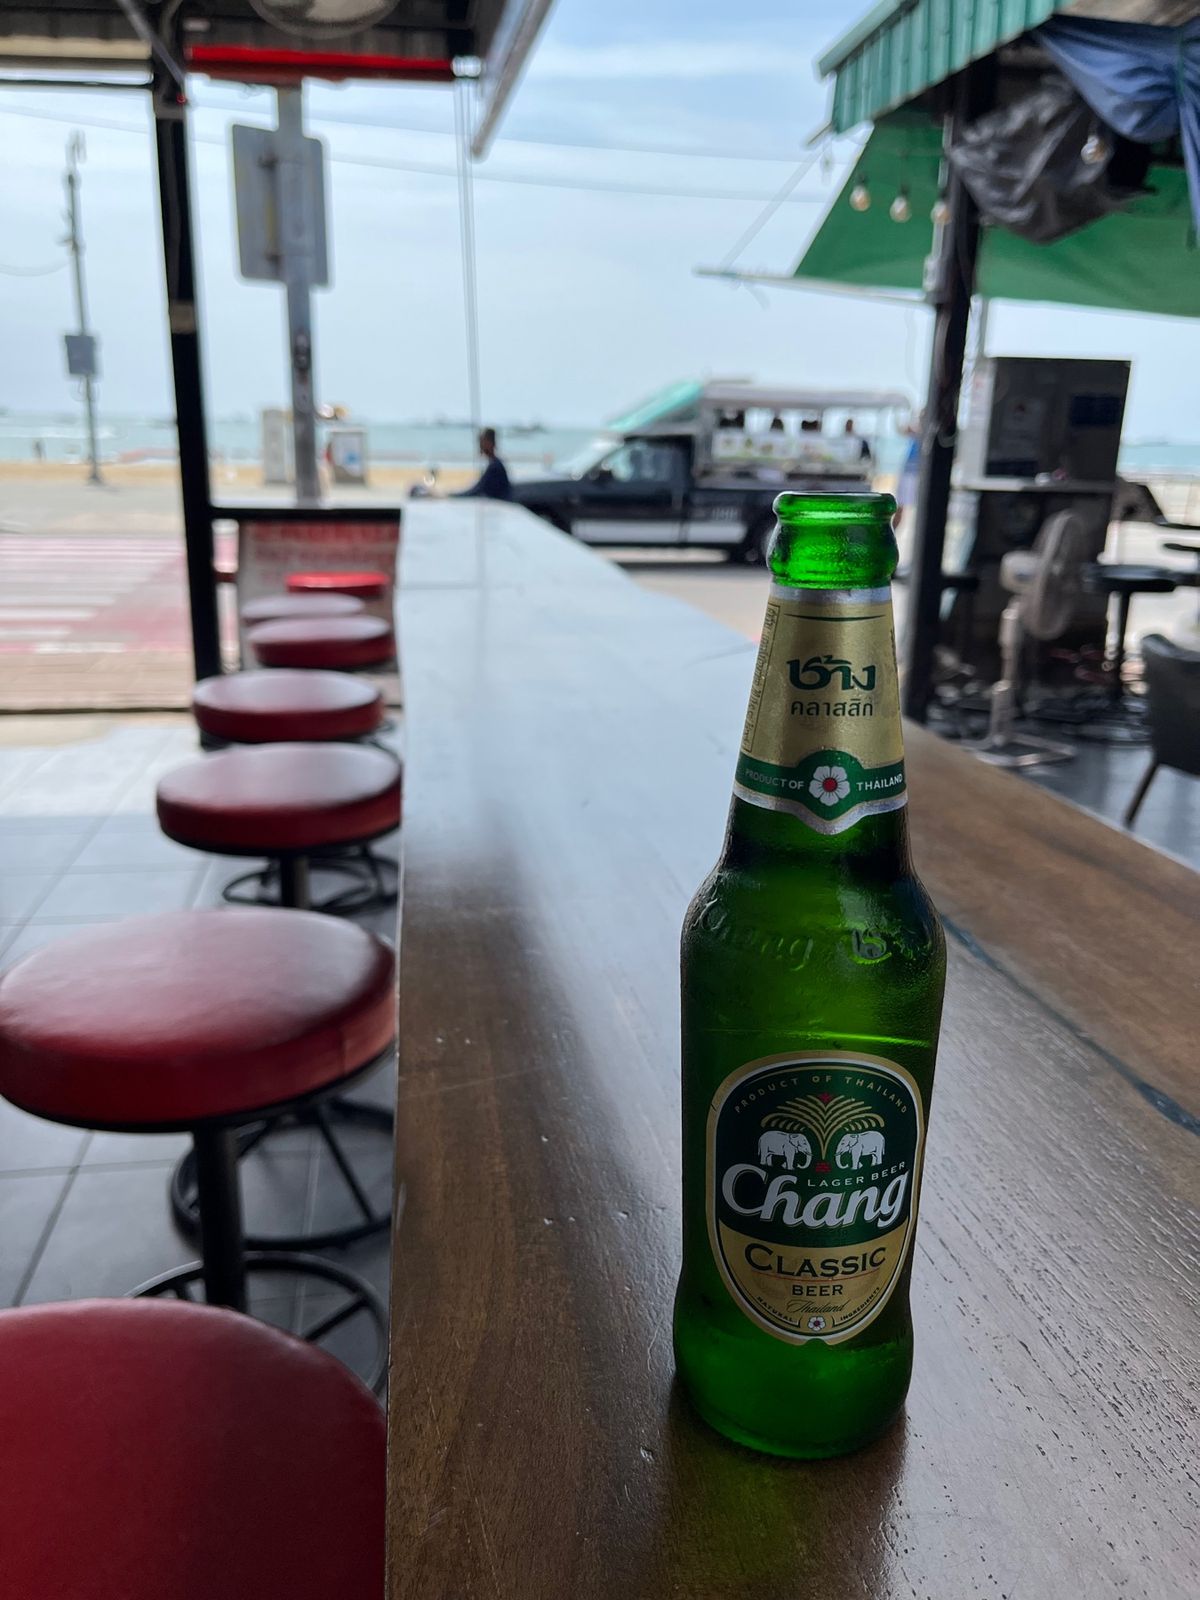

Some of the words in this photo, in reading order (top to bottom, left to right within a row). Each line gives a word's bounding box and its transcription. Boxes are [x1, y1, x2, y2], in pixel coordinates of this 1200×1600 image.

[786, 655, 876, 691] ช้าง
[744, 768, 786, 787] PRODUCT
[788, 779, 805, 790] OF
[856, 773, 903, 792] THAILAND
[734, 1078, 799, 1114] PRODUCT
[811, 1075, 833, 1084] OF
[844, 1075, 908, 1114] THAILAND
[807, 1176, 865, 1188] LAGER
[871, 1161, 906, 1182] BEER
[721, 1163, 911, 1228] Chang
[744, 1243, 887, 1278] CLASSIC
[792, 1284, 843, 1297] BEER
[756, 1296, 795, 1323] NATURAL
[786, 1298, 850, 1314] Thailand
